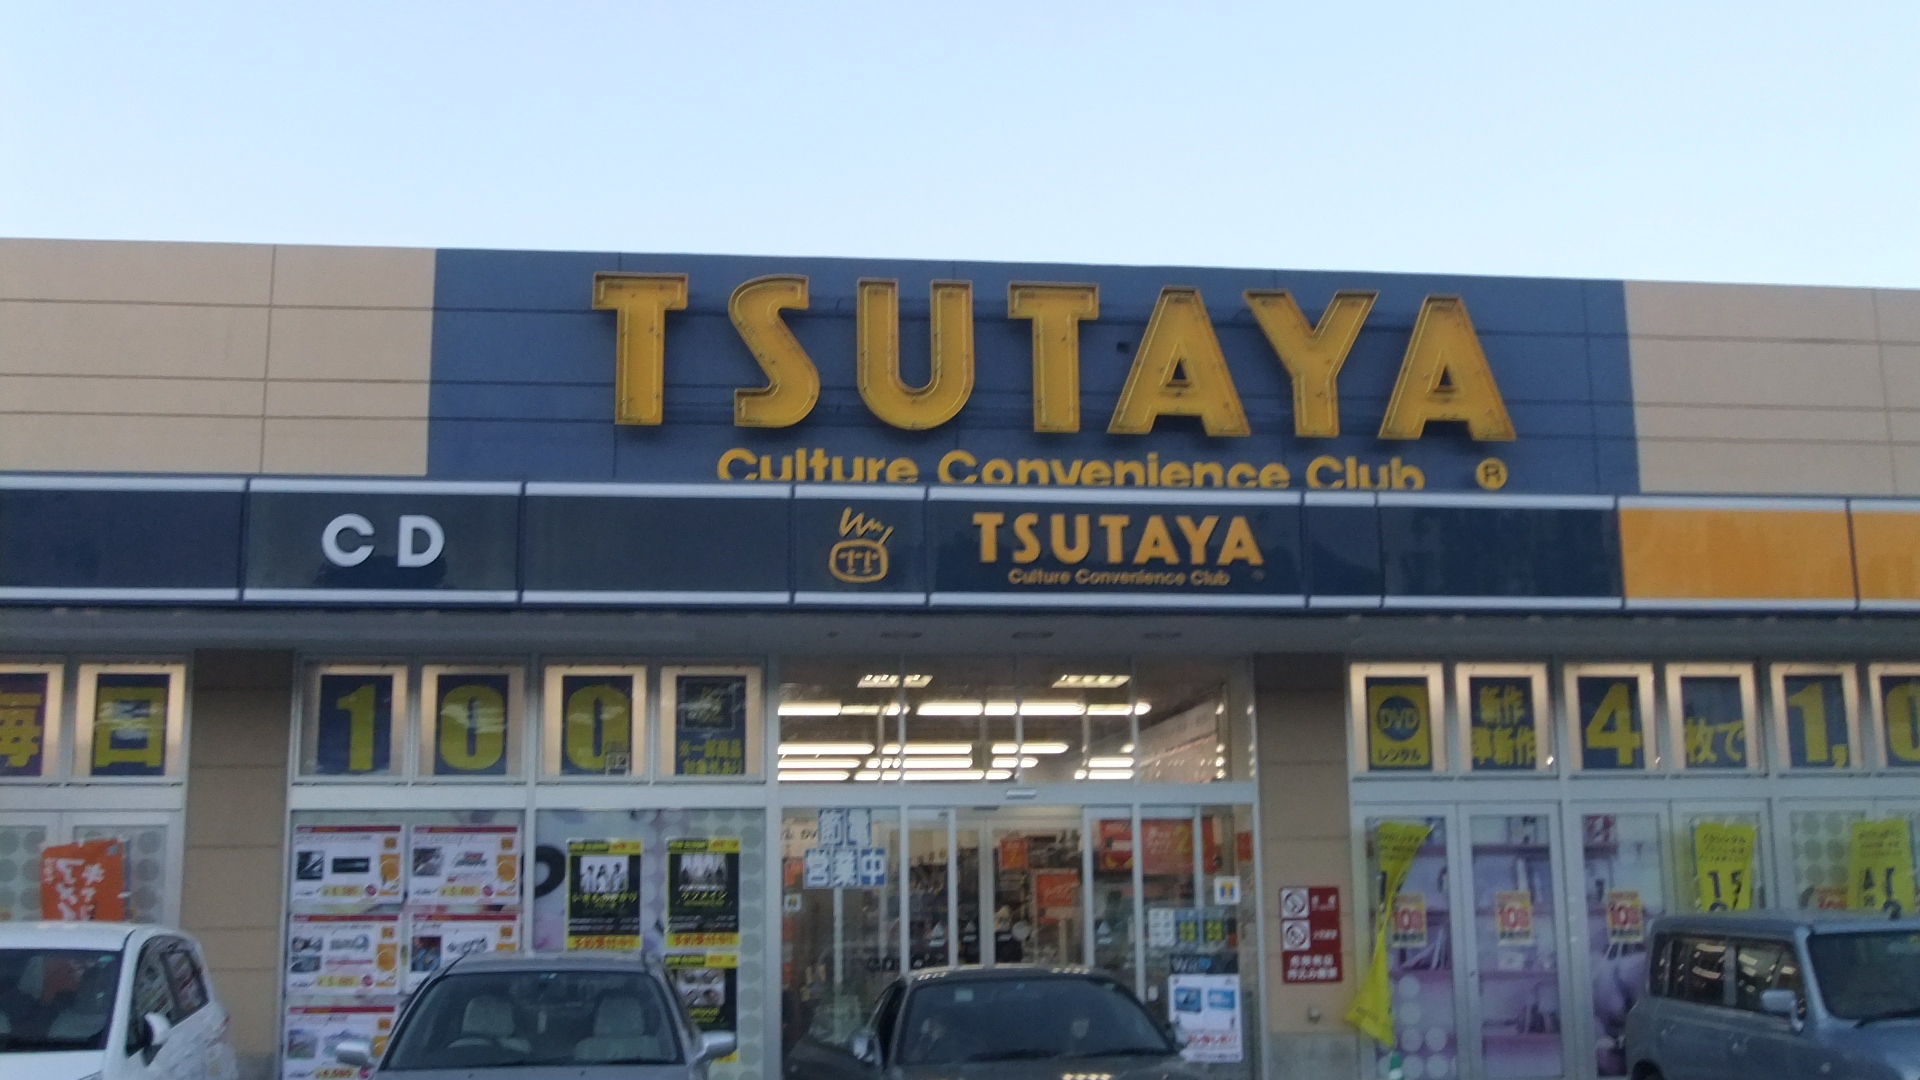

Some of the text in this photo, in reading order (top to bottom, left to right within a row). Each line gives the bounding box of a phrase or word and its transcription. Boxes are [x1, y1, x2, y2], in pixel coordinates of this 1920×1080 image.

[591, 271, 1517, 442] TSUTAYA
[717, 448, 919, 481] Culture
[937, 449, 1291, 488] Convenience
[1305, 455, 1426, 490] Club
[973, 512, 1264, 566] TSUTAYA
[1008, 568, 1230, 586] Culture Convenience Club
